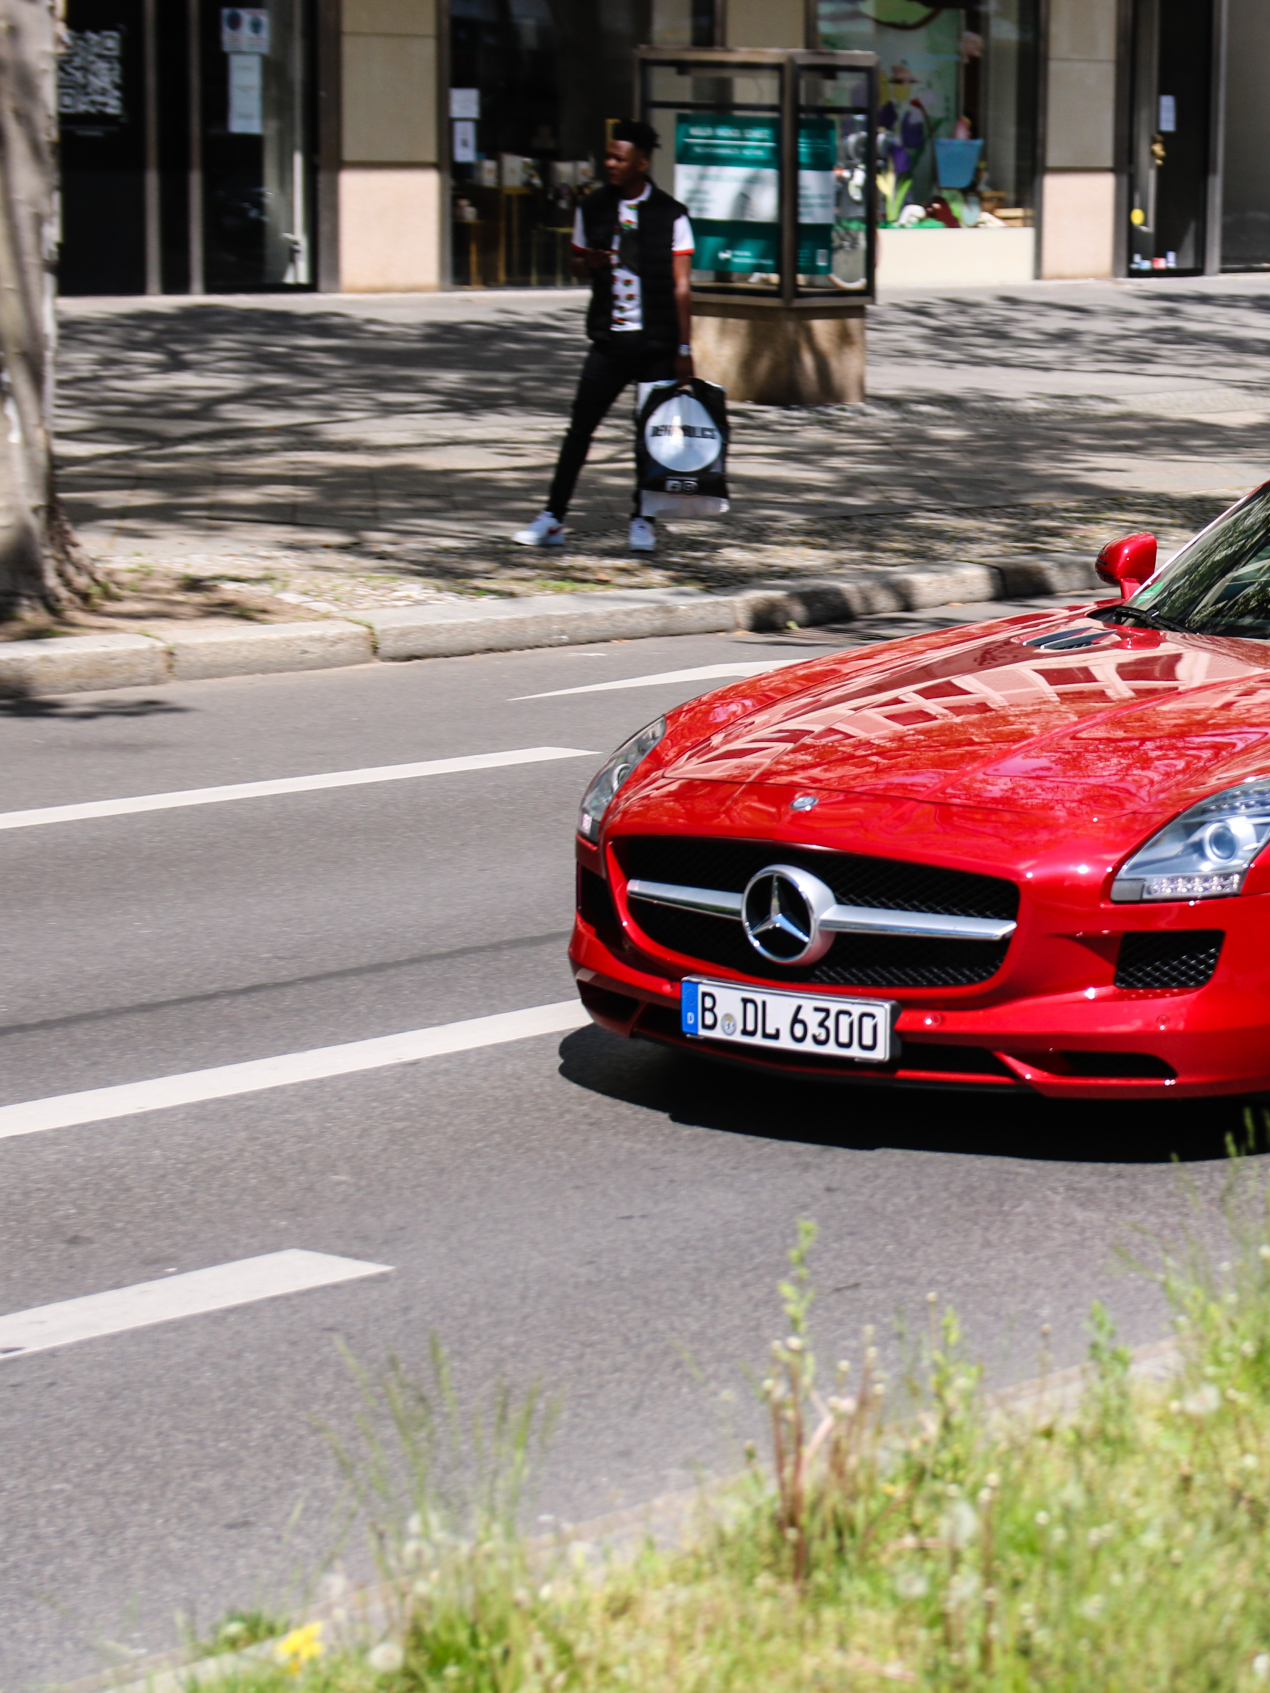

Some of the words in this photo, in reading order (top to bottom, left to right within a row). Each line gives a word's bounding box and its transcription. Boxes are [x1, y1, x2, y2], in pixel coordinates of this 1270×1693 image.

[701, 991, 718, 1030] B
[741, 997, 780, 1041] DL
[790, 1004, 878, 1052] 6300
